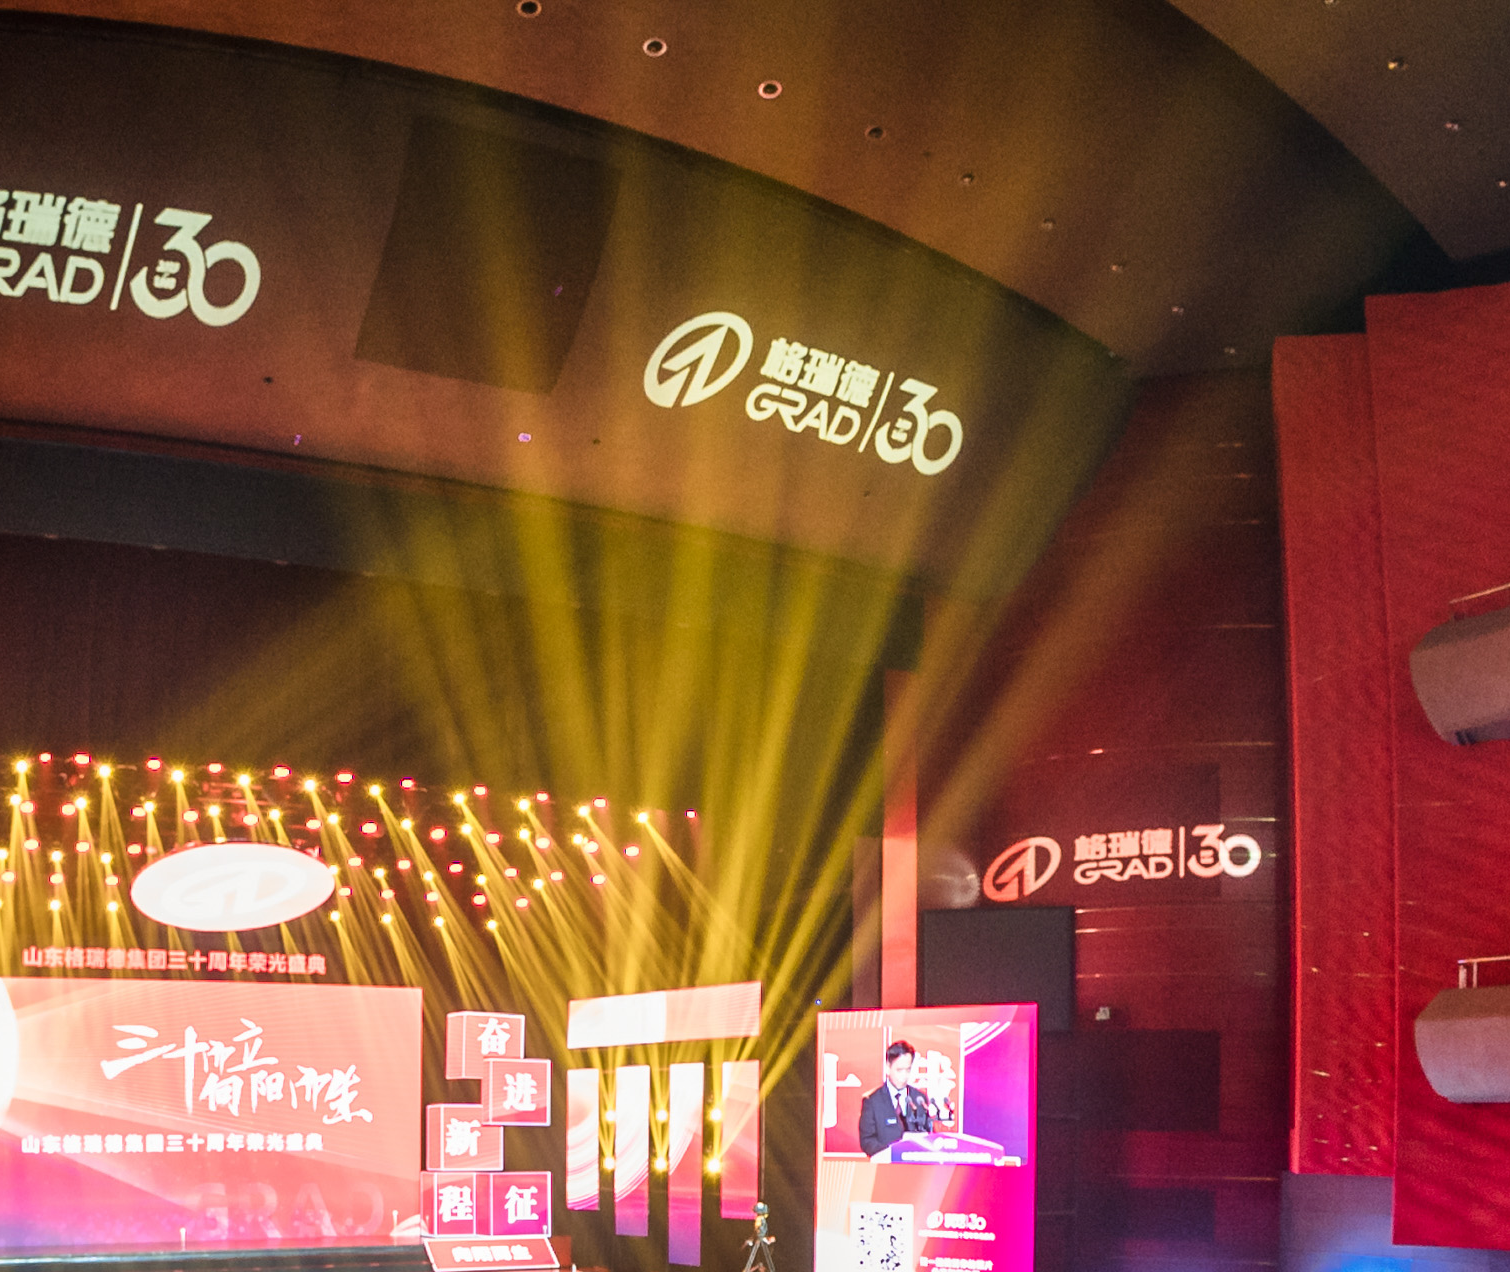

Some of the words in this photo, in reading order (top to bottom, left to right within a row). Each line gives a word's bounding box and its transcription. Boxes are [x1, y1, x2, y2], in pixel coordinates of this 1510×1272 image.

[761, 337, 881, 408] 格瑞德
[745, 384, 862, 446] GRAD
[1074, 827, 1173, 863] 格瑞德
[1073, 857, 1174, 886] GRAD
[22, 945, 327, 976] 山东格瑞德集团三十周年荣光盛典
[477, 1018, 511, 1056] 奋
[503, 1072, 538, 1112] 进
[445, 1117, 482, 1157] 新
